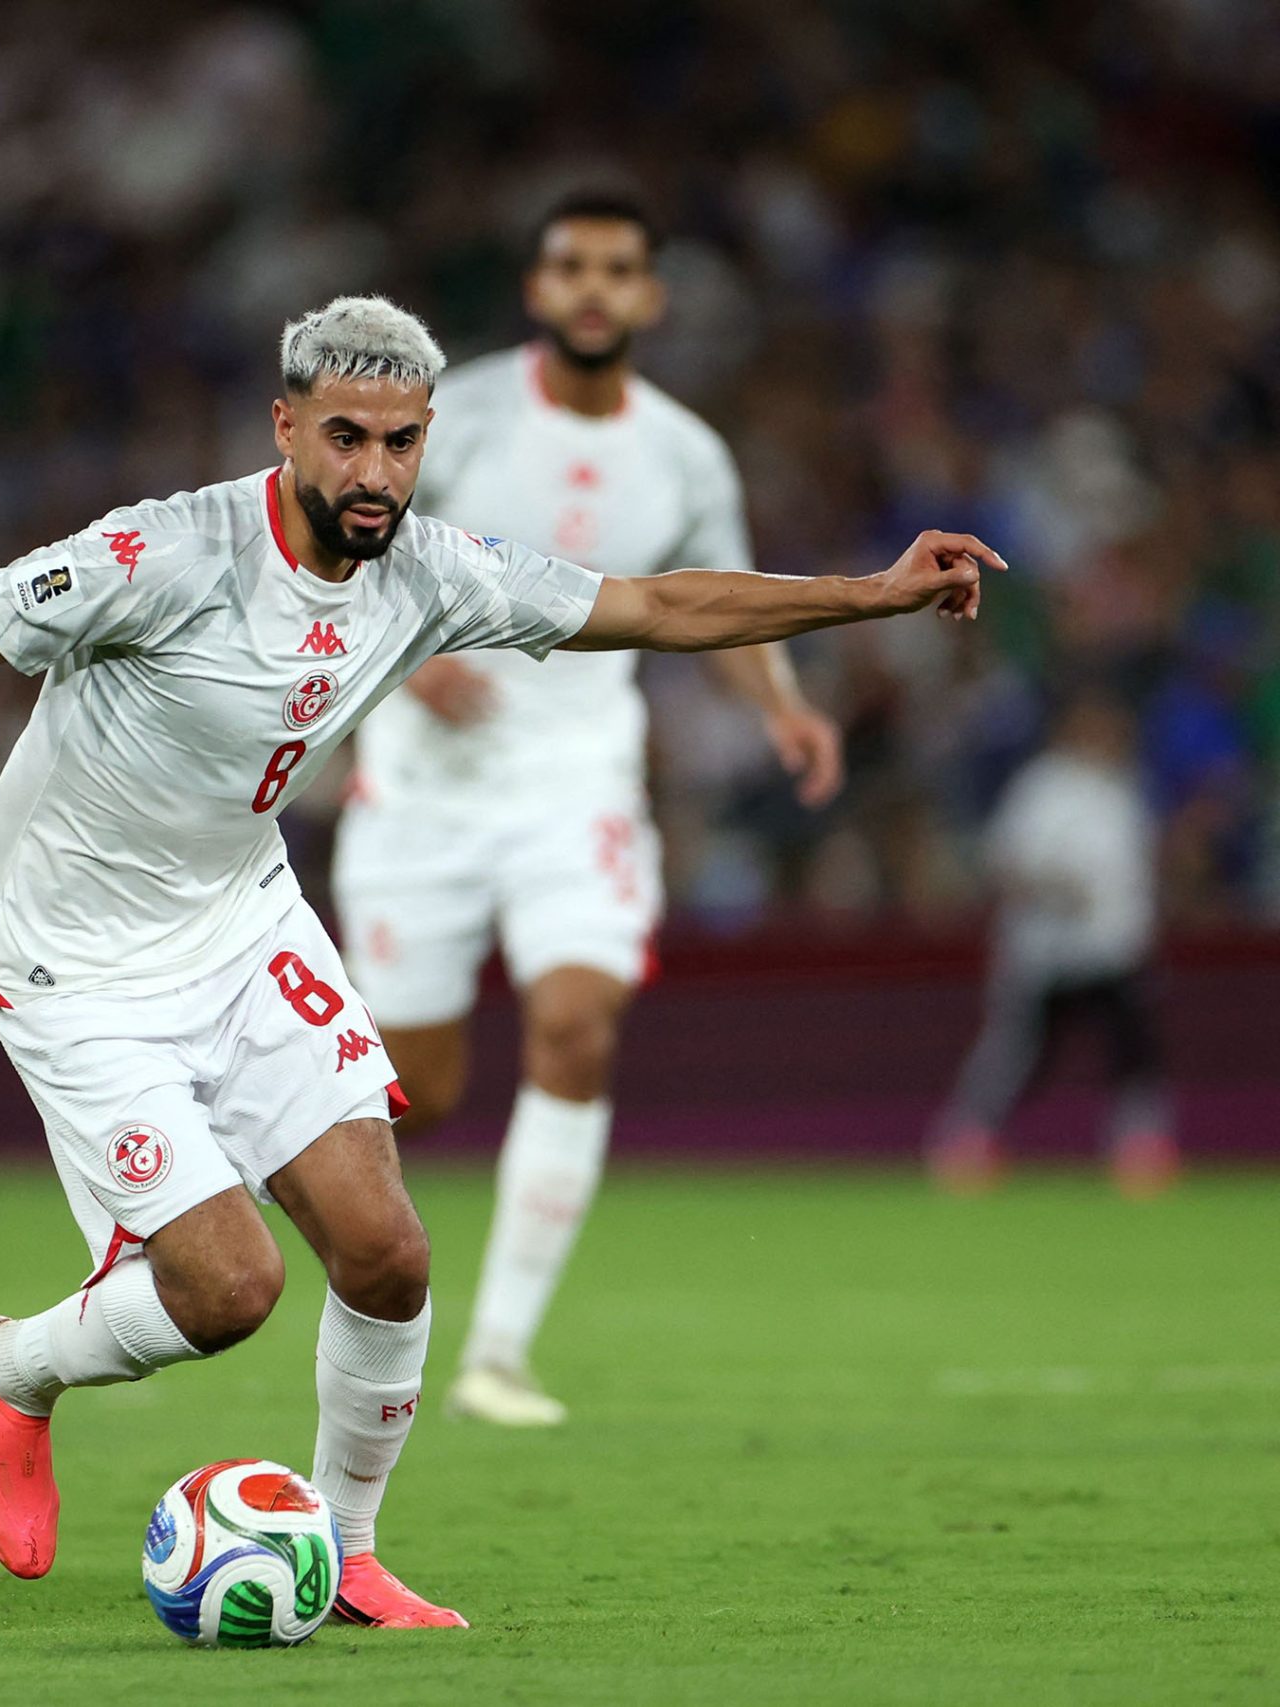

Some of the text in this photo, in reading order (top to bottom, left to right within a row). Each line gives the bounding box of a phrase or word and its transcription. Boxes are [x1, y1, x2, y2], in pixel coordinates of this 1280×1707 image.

[17, 582, 30, 610] 2026
[251, 740, 307, 814] 8
[268, 951, 344, 1026] 8
[381, 1392, 421, 1422] FT
